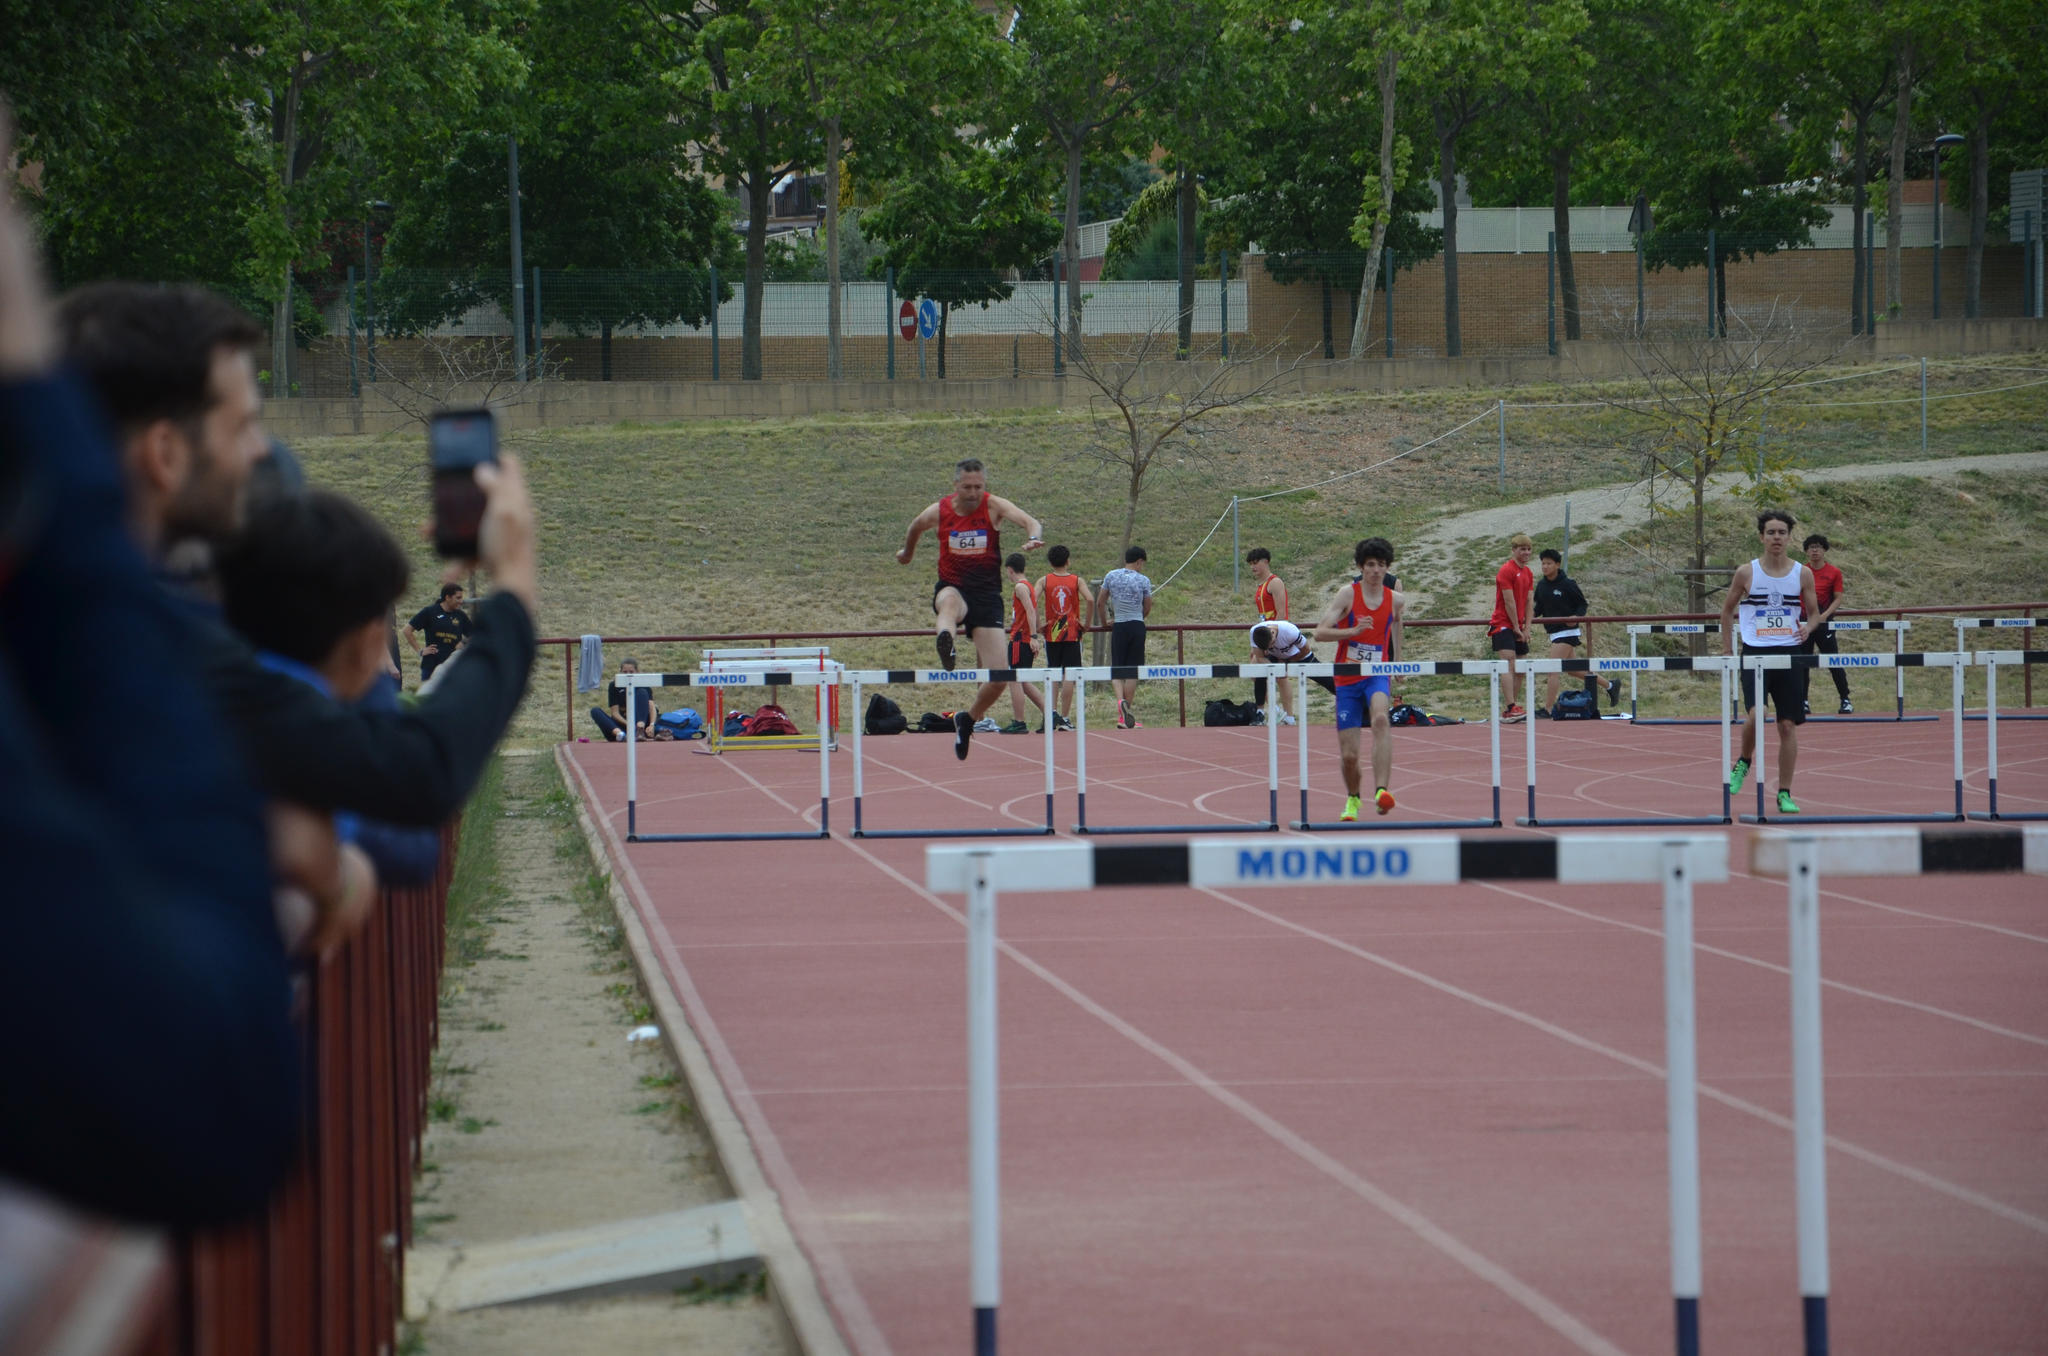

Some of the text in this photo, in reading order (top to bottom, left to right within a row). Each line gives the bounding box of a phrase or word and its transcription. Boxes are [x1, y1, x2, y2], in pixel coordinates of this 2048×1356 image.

[960, 538, 975, 549] 64
[1767, 617, 1783, 628] 50
[1357, 650, 1372, 662] 54
[1828, 655, 1879, 666] MONDO
[1371, 663, 1421, 674] MONDO
[1599, 659, 1649, 670] MONDO
[928, 671, 976, 682] MONDO
[1147, 666, 1196, 677] MONDO
[698, 674, 747, 685] MONDO
[1238, 848, 1410, 878] MONDO
